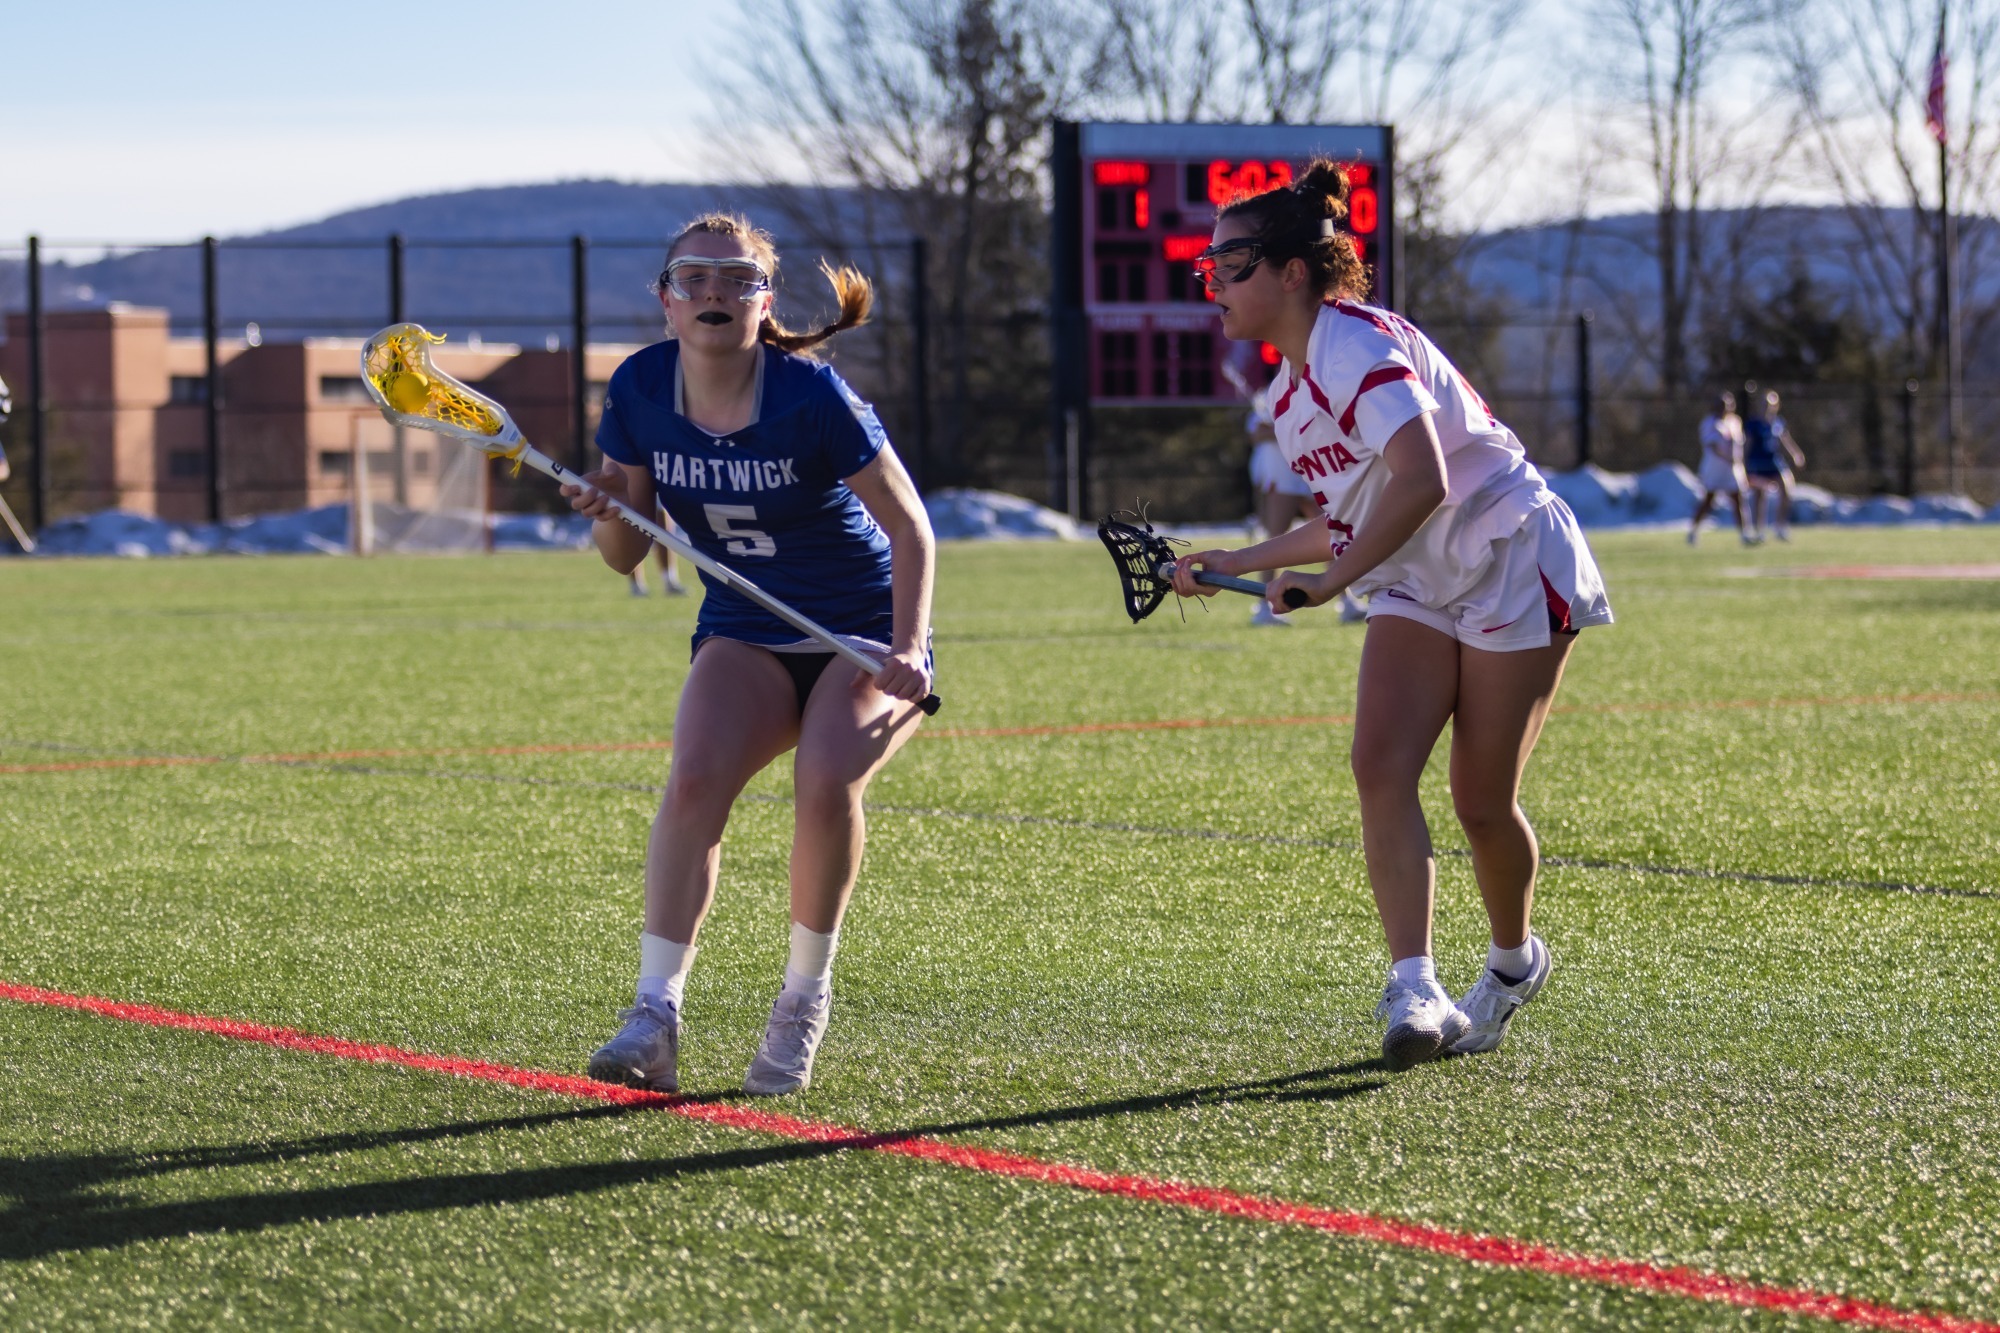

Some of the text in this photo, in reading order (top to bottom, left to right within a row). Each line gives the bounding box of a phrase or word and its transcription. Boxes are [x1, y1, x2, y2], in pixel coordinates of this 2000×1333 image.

[1350, 187, 1378, 234] 0
[653, 451, 800, 492] HARTWICK
[703, 503, 778, 558] 5
